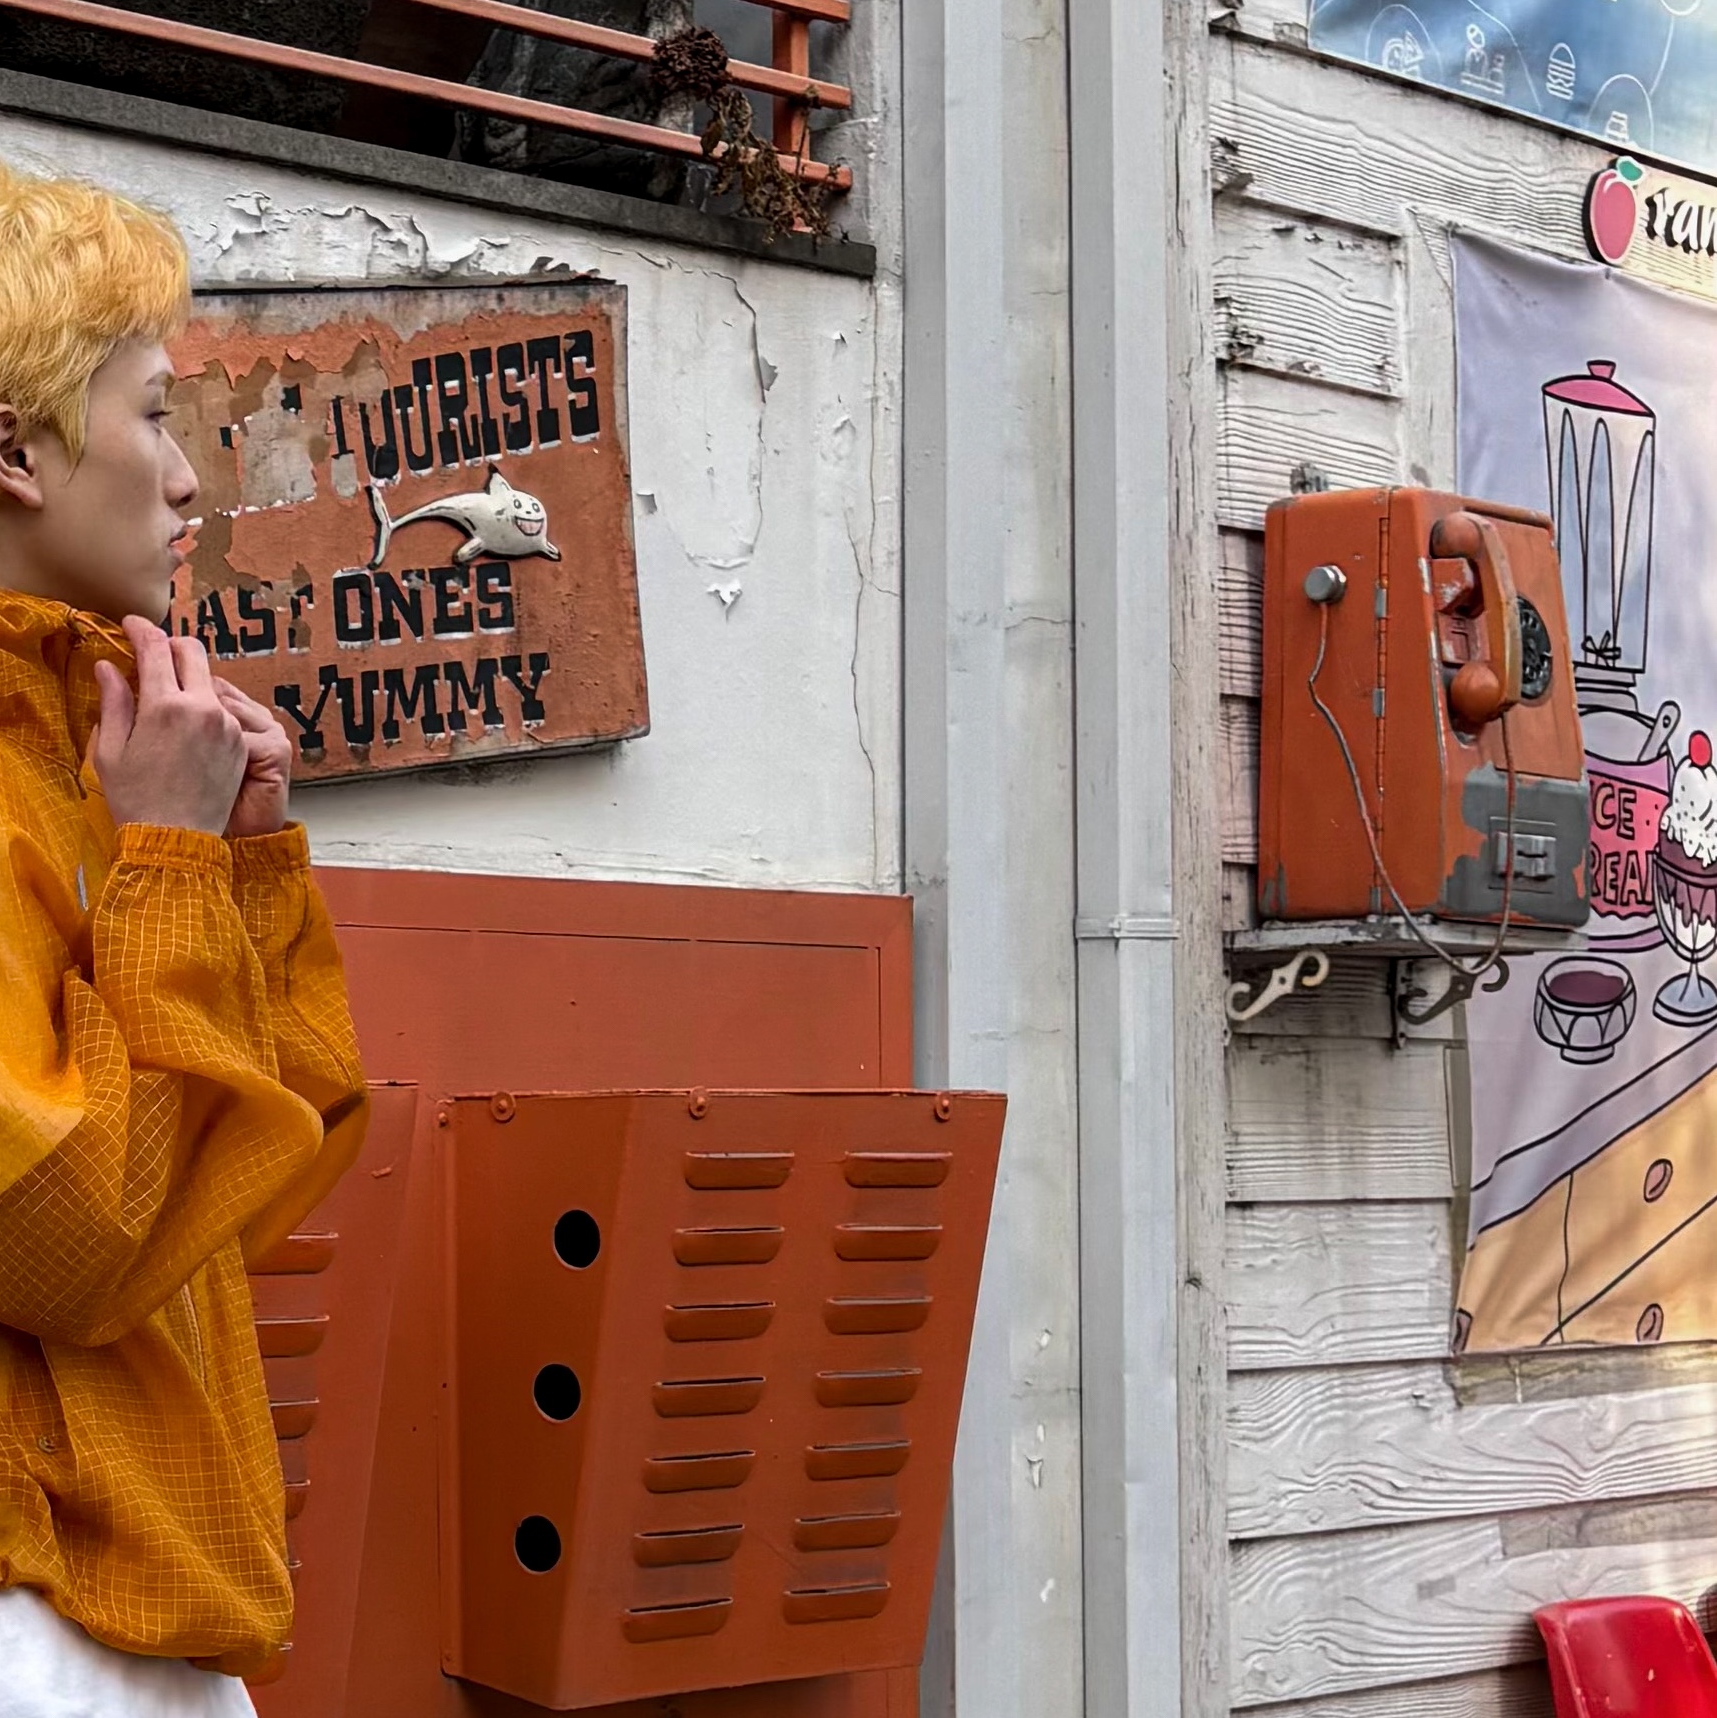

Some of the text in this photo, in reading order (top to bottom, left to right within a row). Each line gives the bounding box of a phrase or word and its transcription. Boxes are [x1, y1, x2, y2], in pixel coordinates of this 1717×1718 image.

[332, 562, 515, 648] ONES
[273, 652, 551, 752] YUMMY
[1589, 779, 1637, 841] CE
